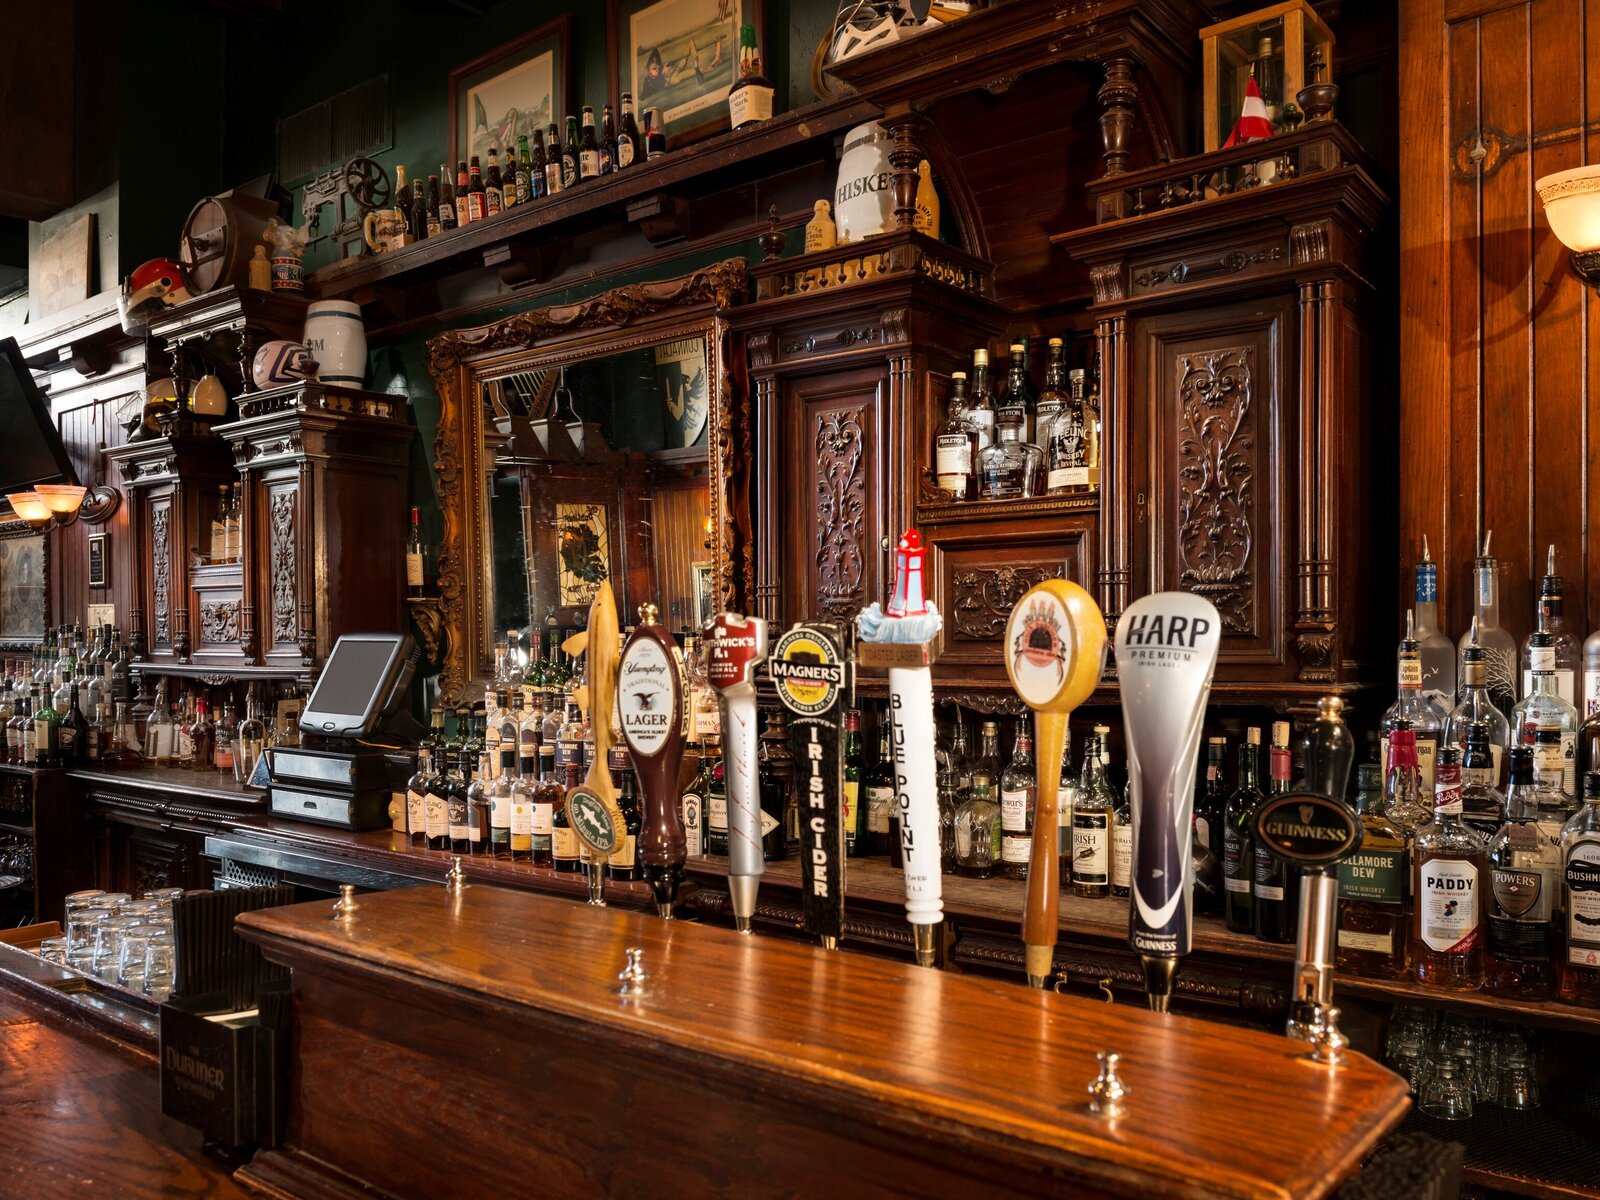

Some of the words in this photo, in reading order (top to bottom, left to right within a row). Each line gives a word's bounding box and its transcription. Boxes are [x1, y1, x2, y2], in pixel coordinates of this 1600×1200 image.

[1125, 614, 1210, 648] HARP
[864, 648, 893, 661] TOASTED
[1131, 650, 1191, 662] PREMIUM
[623, 661, 667, 676] Yuengling
[773, 662, 840, 682] MAGNERS
[627, 677, 666, 689] TRADITIONAL
[674, 650, 690, 732] LAGER
[626, 714, 668, 726] LAGER
[891, 693, 906, 764] BLUE
[807, 726, 825, 810] IRISH
[896, 774, 915, 863] POINT
[1265, 821, 1347, 842] GUINNESS
[596, 836, 609, 846] IPA
[809, 816, 829, 898] CIDER
[1352, 866, 1376, 879] DEW
[1495, 873, 1536, 887] POWERS
[1360, 885, 1386, 894] WHISKEY
[1427, 876, 1474, 890] PADDY
[1135, 936, 1177, 951] GUINNESS
[165, 1045, 226, 1092] DUBLINER
